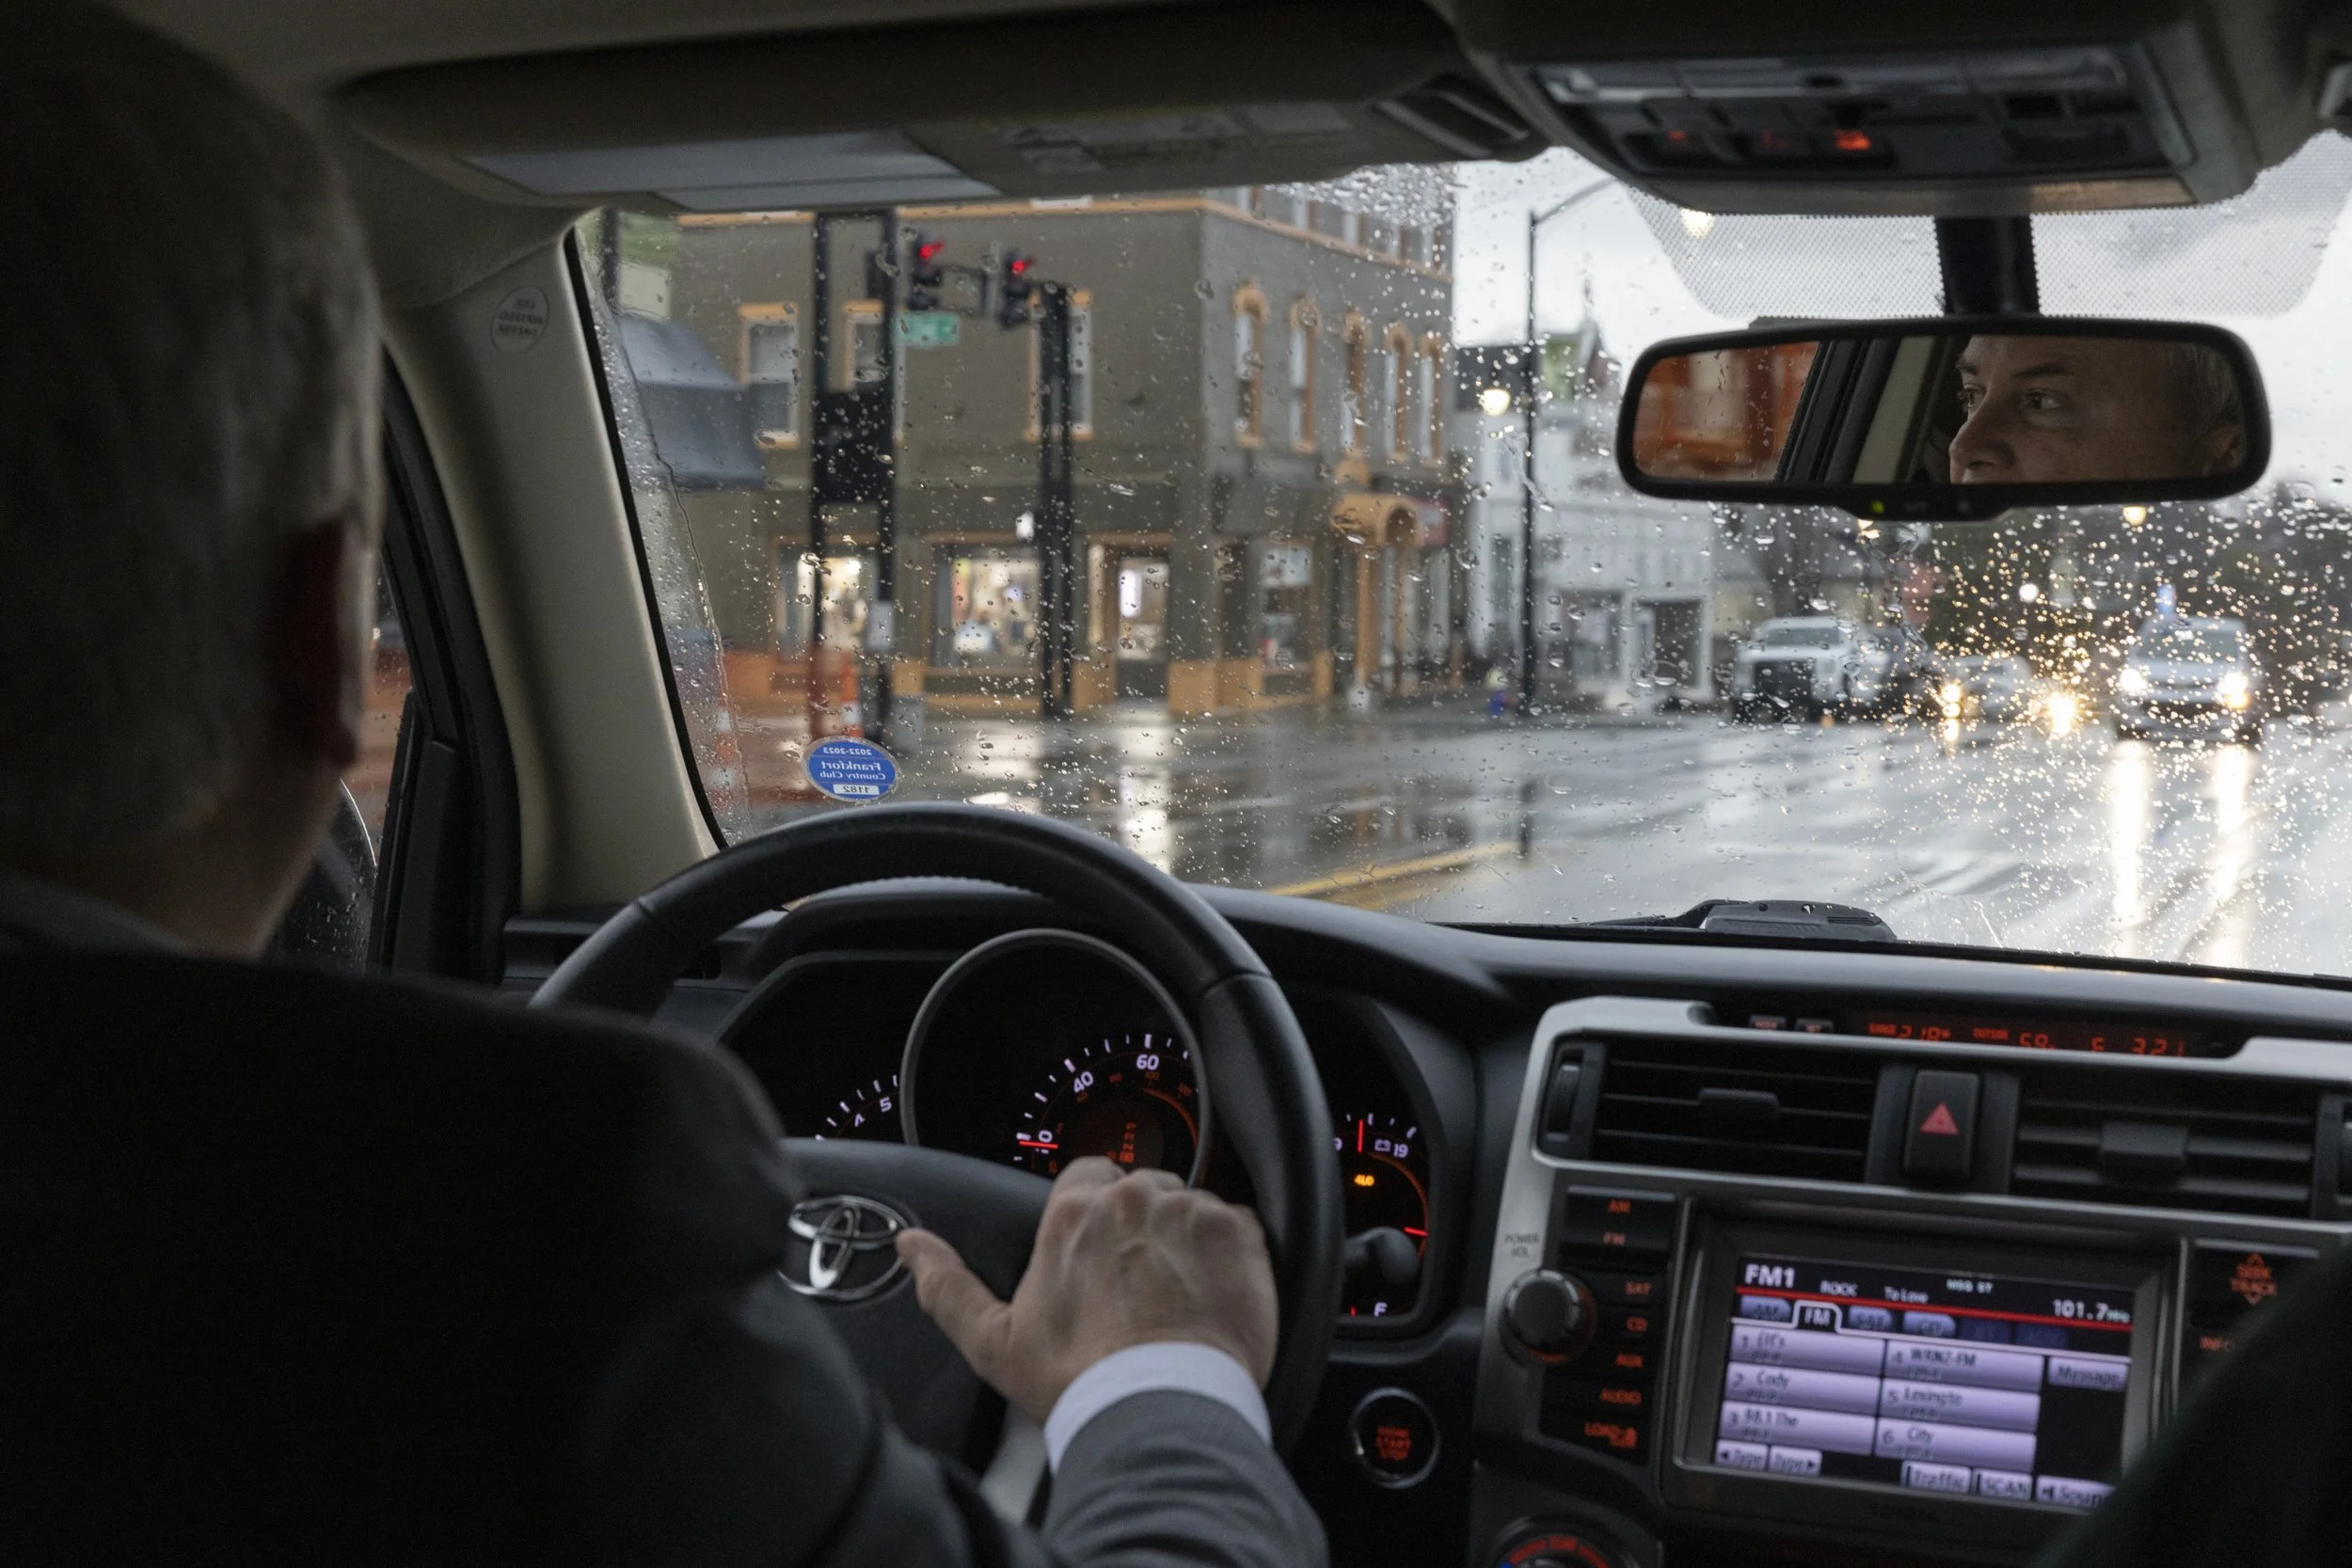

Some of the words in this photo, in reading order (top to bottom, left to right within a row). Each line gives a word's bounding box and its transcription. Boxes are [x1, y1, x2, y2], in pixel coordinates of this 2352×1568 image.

[1136, 1053, 1159, 1070] 60
[1073, 1070, 1094, 1093] 40
[879, 1097, 893, 1113] 5
[1038, 1130, 1053, 1143] 0
[1392, 1143, 1409, 1159] 19
[1608, 1199, 1630, 1213] AM
[1603, 1231, 1626, 1245] FM
[1744, 1263, 1796, 1289] FM1
[1624, 1280, 1651, 1295] SAT
[1820, 1280, 1858, 1297] ROCK
[1374, 1301, 1388, 1317] F
[1804, 1307, 1831, 1326] FM
[2052, 1298, 2108, 1321] 101.7
[1626, 1316, 1648, 1332] CD
[1600, 1388, 1642, 1406] AUDIO
[1984, 1475, 2028, 1495] SCAN
